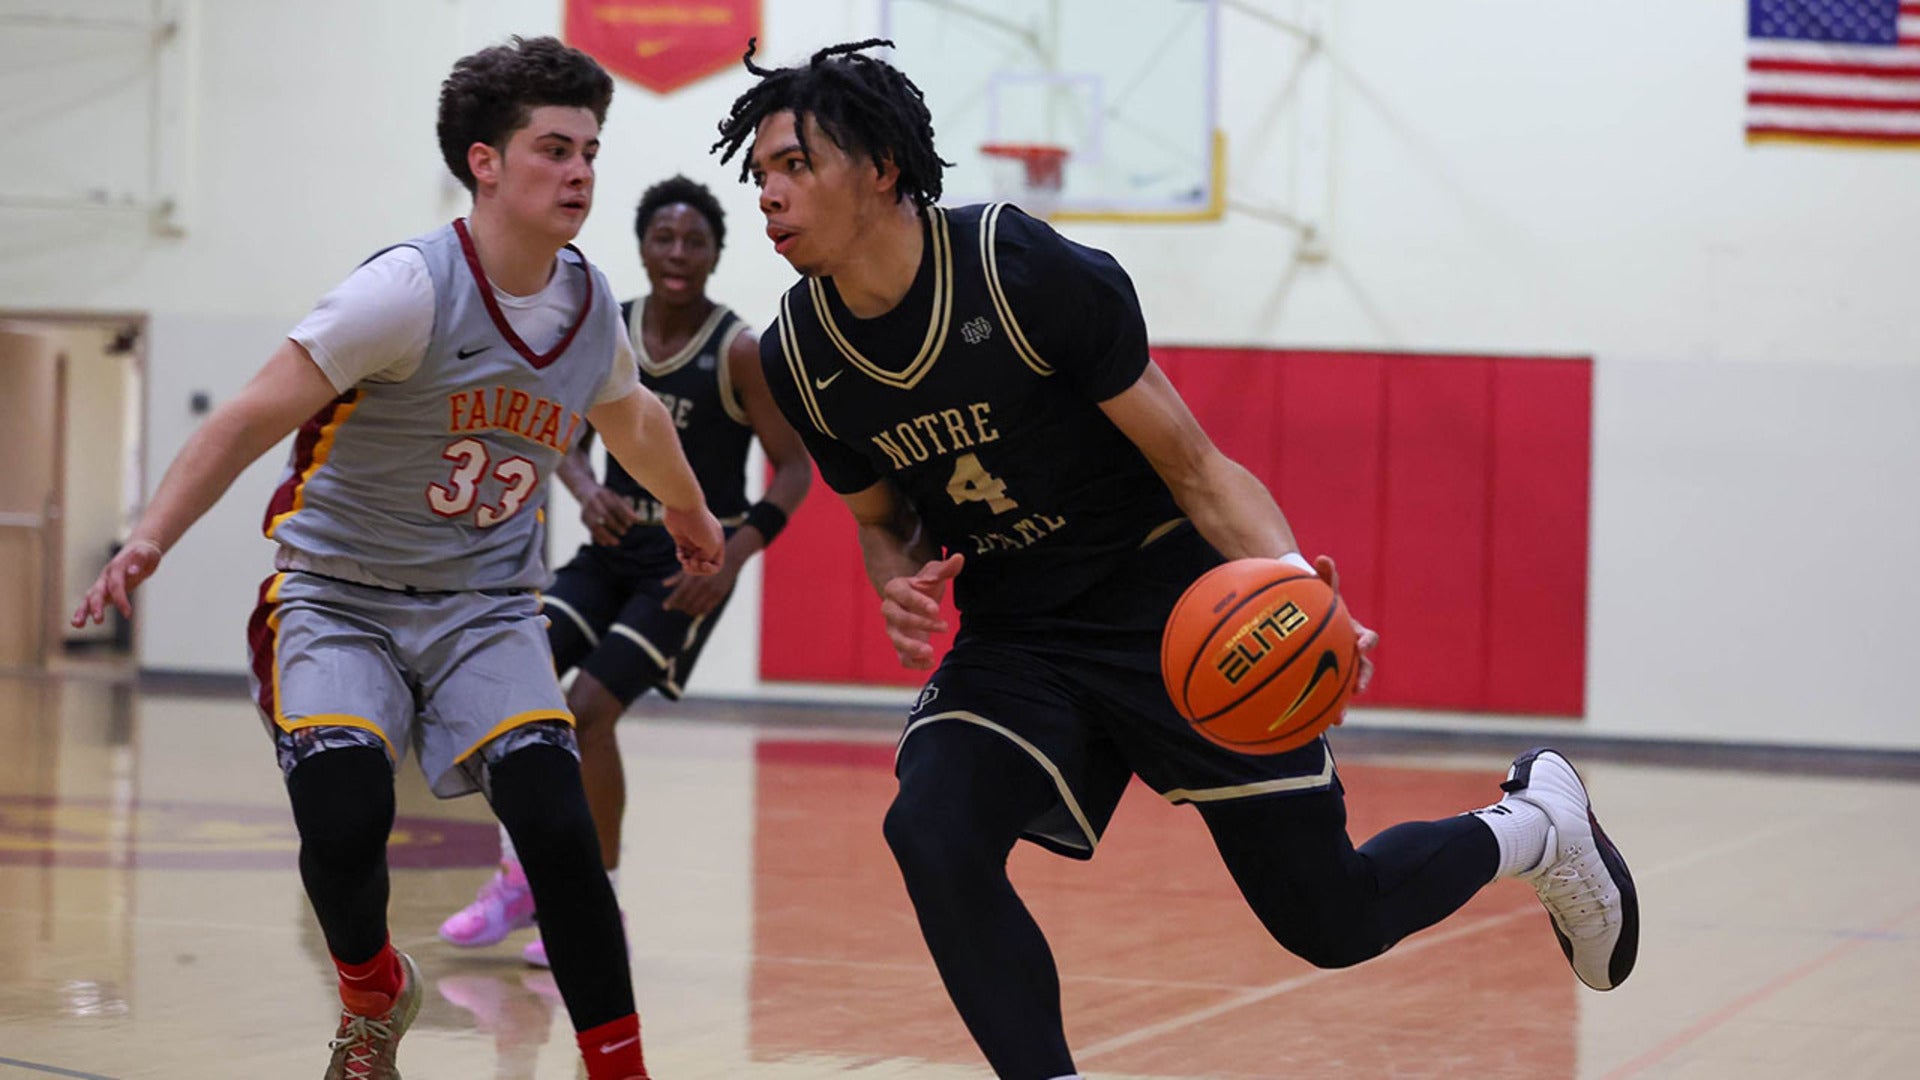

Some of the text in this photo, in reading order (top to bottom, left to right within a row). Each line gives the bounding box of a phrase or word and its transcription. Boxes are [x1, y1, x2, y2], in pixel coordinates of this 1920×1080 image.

[872, 402, 999, 470] NOTRE
[425, 436, 538, 529] 33
[946, 452, 1019, 515] 4
[1217, 600, 1310, 685] ELITE
